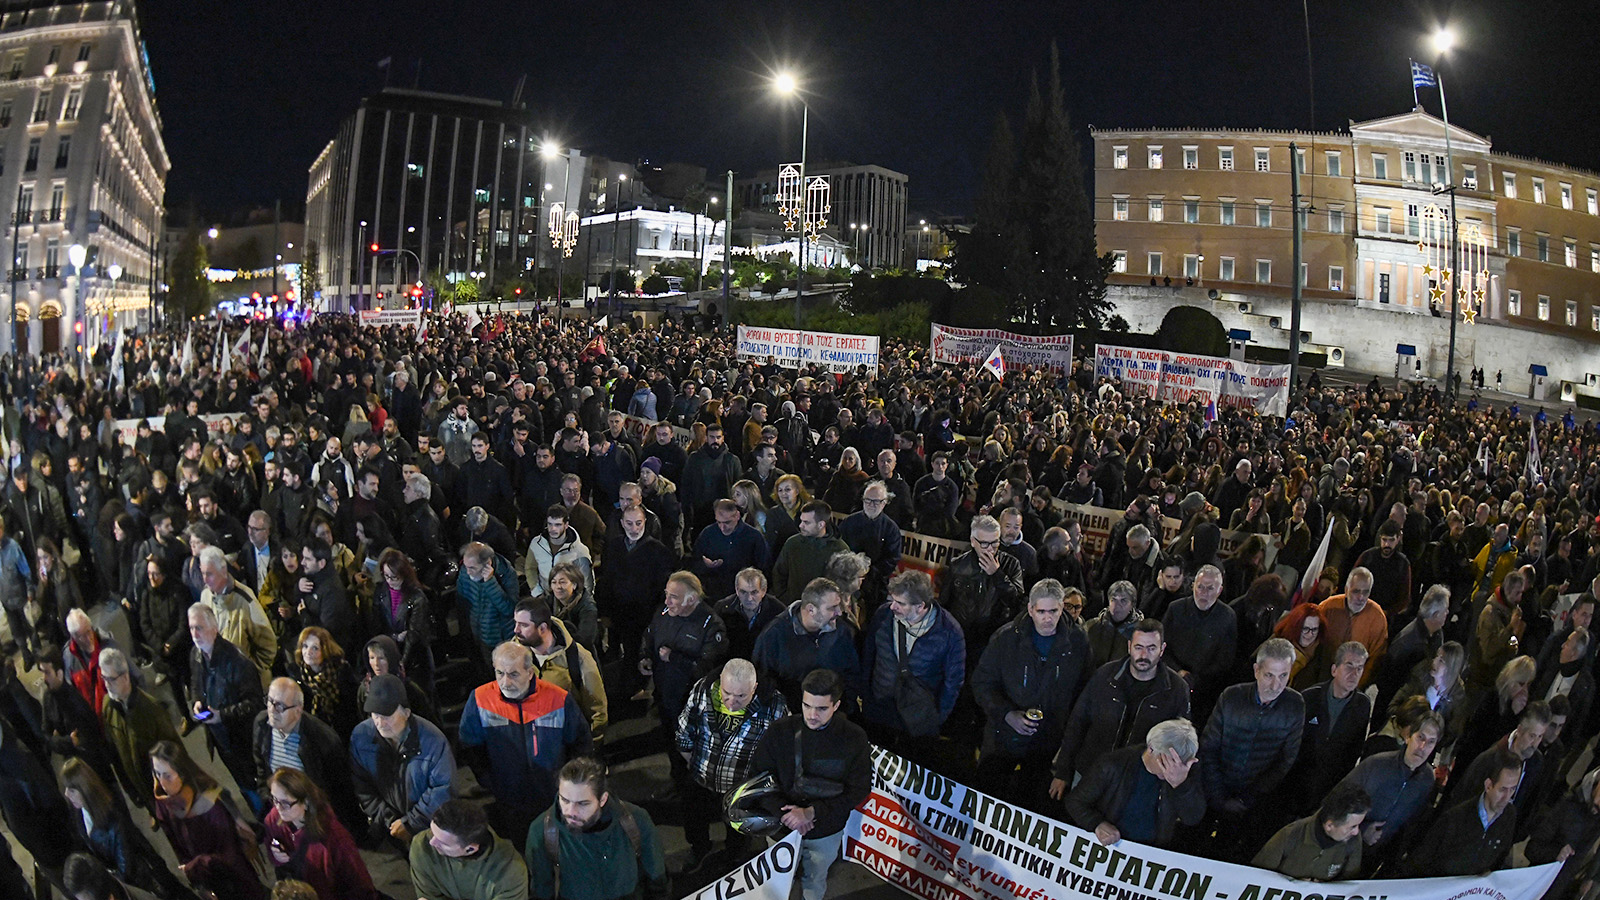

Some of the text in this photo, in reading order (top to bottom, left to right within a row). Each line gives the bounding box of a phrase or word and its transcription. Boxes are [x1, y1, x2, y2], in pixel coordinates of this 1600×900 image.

[746, 329, 867, 351] ΦΟΡΟΙ ΚΑΙ ΘΥΣΙΕΣ ΓΙΑ ΤΟΥΣ ΕΡΓΑΤΕΣ
[772, 344, 783, 356] ΓΙΑ
[785, 346, 813, 360] ΠΟΛΕΜΟ
[820, 349, 878, 365] ΚΕΦΑΛΑΙΟΚΡΑΤΕΣ
[1097, 346, 1111, 356] ΟΧΙ
[1114, 348, 1133, 359] ΣΤΟΝ
[1136, 350, 1170, 362] ΠΟΛΕΜΙΚΟ
[1097, 366, 1109, 376] ΚΑΙ
[1112, 367, 1121, 377] ΤΑ
[1161, 372, 1196, 387] ΣΦΑΓΕΙΑ!
[1101, 357, 1124, 367] ΛΕΦΤΑ
[1126, 359, 1138, 369] ΓΙΑ
[1142, 361, 1158, 371] ΤΗΝ
[1162, 363, 1190, 376] ΠΑΙΔΕΙΑ
[1197, 368, 1210, 378] ΟΧΙ
[1213, 370, 1225, 380] ΓΙΑ
[1229, 372, 1247, 385] ΤΟΥΣ
[1250, 376, 1288, 389] ΠΟΛΕΜΟΥΣ
[900, 536, 962, 566] ΗΝ ΚΡΙΣ
[870, 747, 957, 809] ΟΙΝΟΣ
[959, 788, 1069, 860] ΑΓΩΝΑΣ
[1069, 835, 1213, 900] ΕΡΓΑΤΩΝ
[861, 822, 922, 859] φθηνά
[923, 806, 969, 841] ΣΤΗΝ
[969, 826, 1055, 880] ΠΟΛΙΤΙΚΗ
